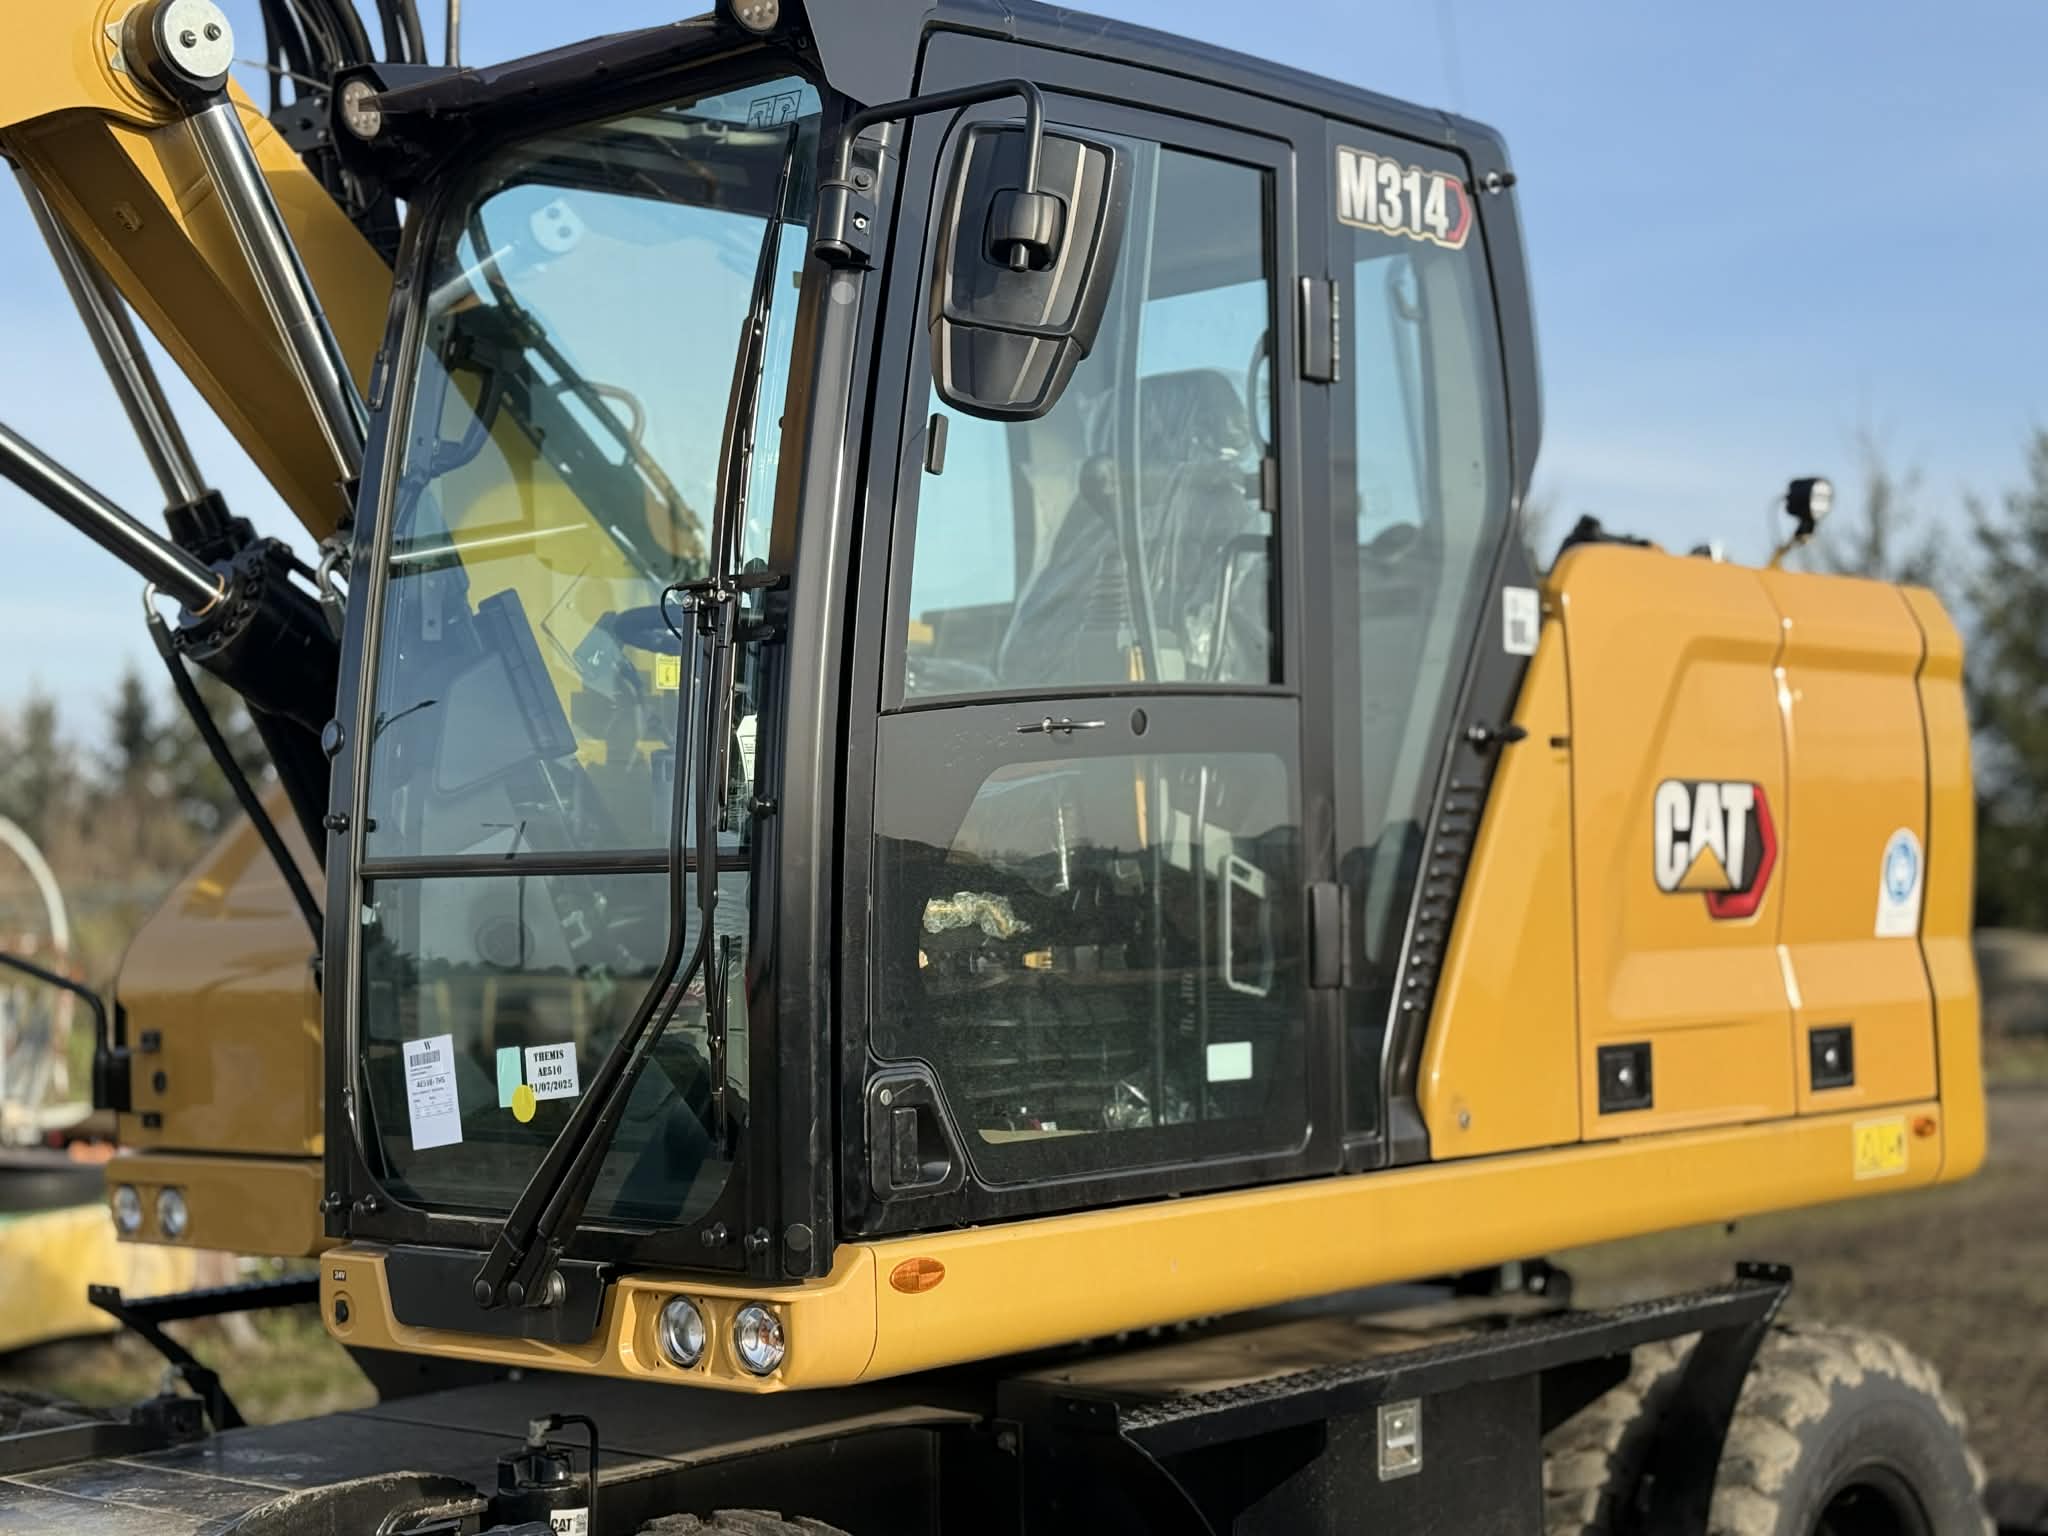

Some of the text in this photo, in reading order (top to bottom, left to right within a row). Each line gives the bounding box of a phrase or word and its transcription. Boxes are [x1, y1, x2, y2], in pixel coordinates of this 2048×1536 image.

[1338, 151, 1449, 239] M314
[1655, 780, 1754, 891] CAT
[533, 1050, 565, 1062] THEMIS
[538, 1065, 562, 1077] AE510
[551, 1518, 573, 1532] CAT
